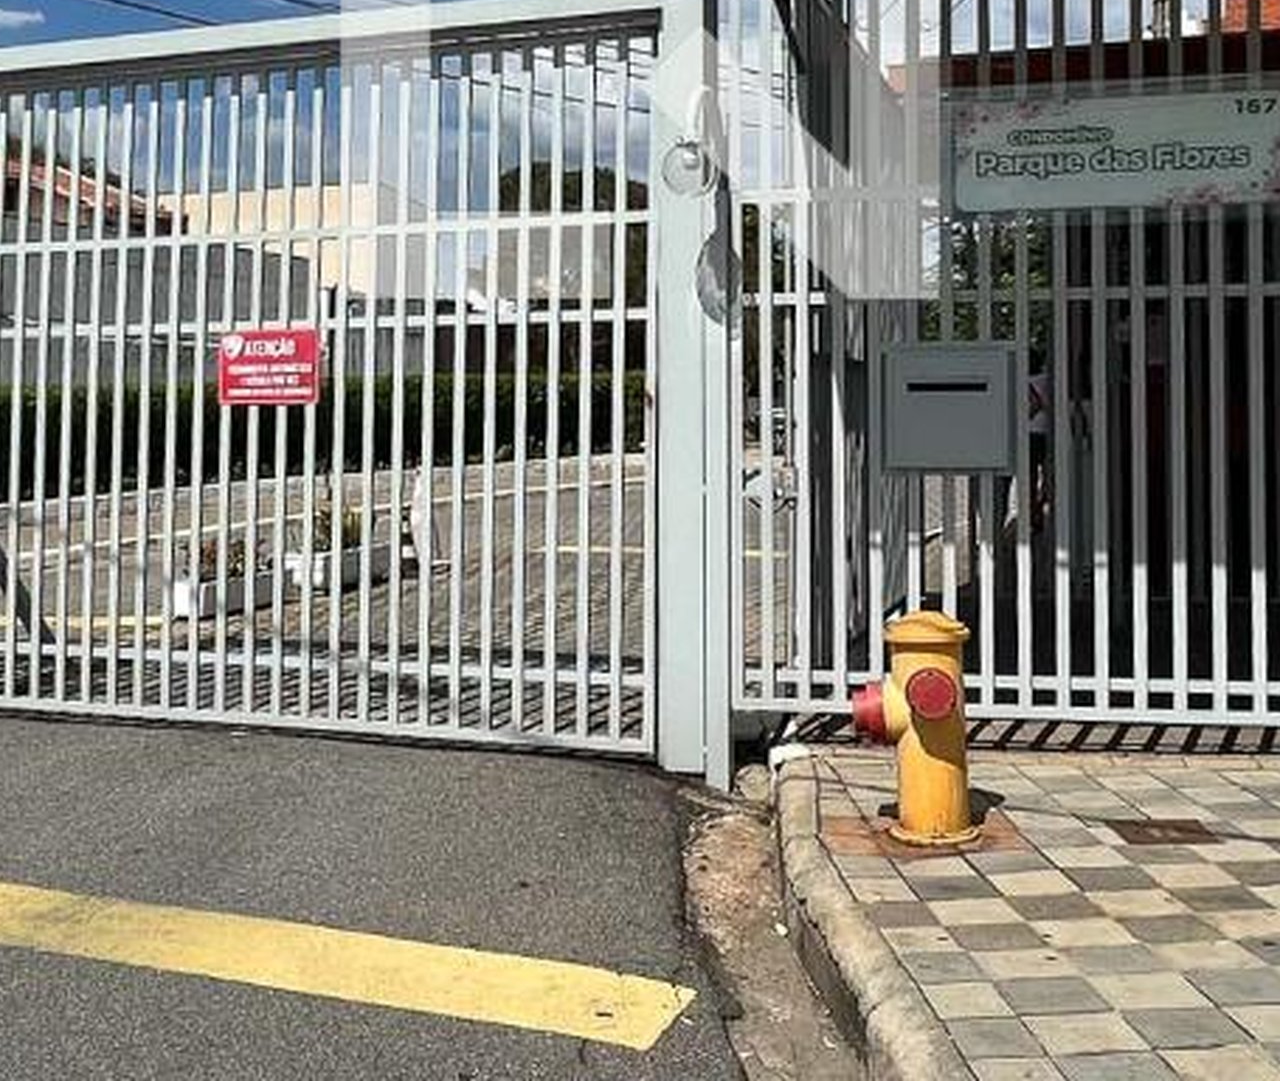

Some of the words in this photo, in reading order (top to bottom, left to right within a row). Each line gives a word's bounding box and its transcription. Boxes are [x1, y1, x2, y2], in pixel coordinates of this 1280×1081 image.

[1235, 99, 1277, 114] 167
[976, 152, 1085, 179] Parque
[1089, 146, 1148, 171] das
[1153, 142, 1251, 170] Flores
